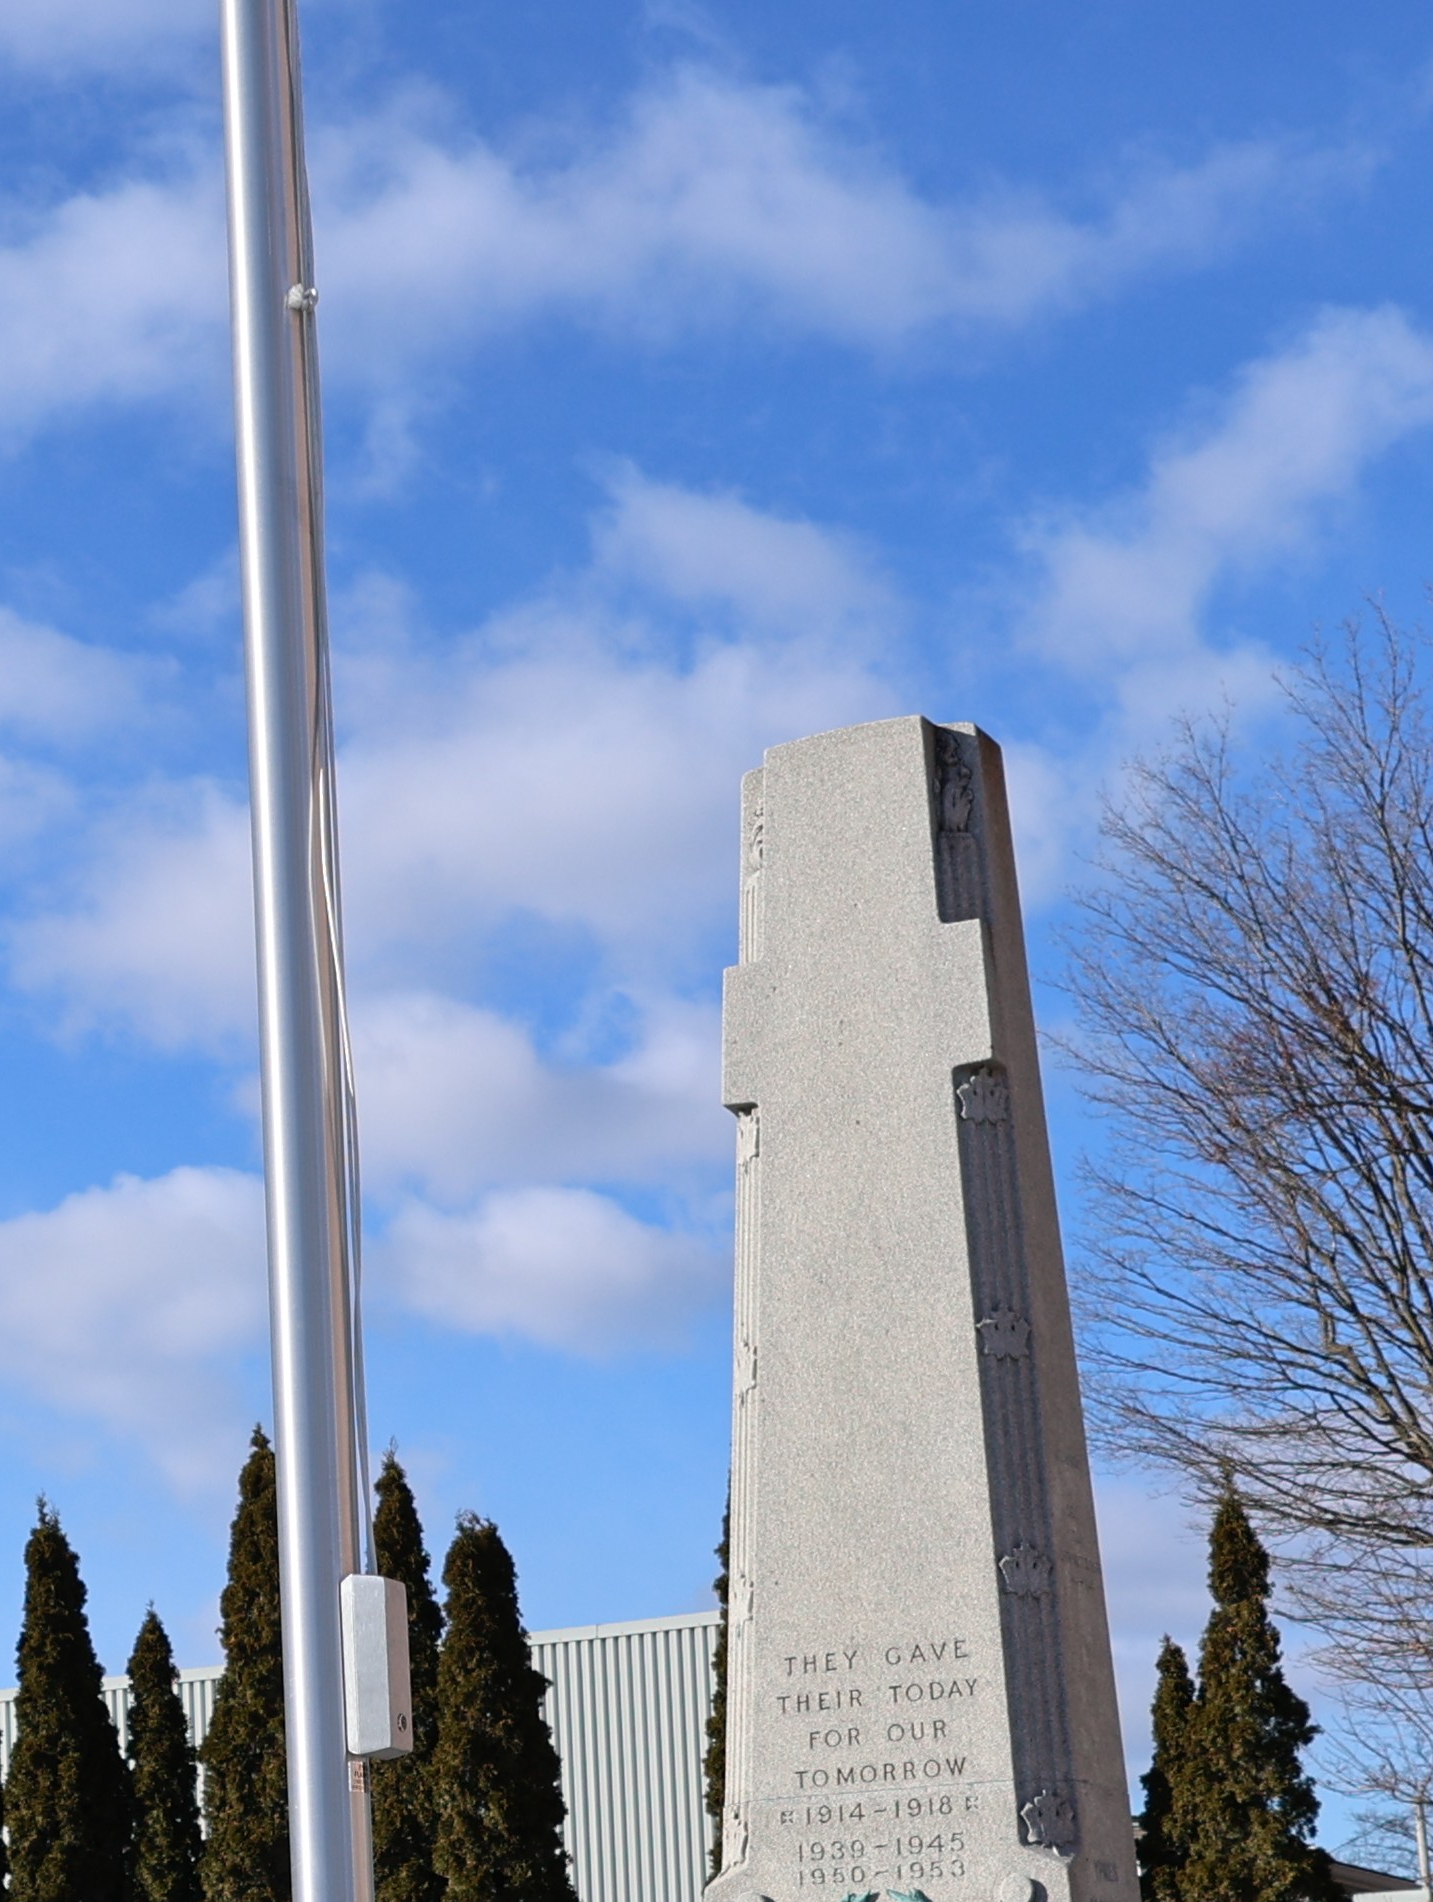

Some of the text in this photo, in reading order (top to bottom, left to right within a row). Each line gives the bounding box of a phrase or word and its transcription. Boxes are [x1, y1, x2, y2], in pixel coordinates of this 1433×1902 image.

[784, 1640, 968, 1676] THEY GAVE
[776, 1678, 978, 1714] THEIR TODAY
[810, 1720, 946, 1749] FOR OUR
[795, 1757, 966, 1788] TOMORROW
